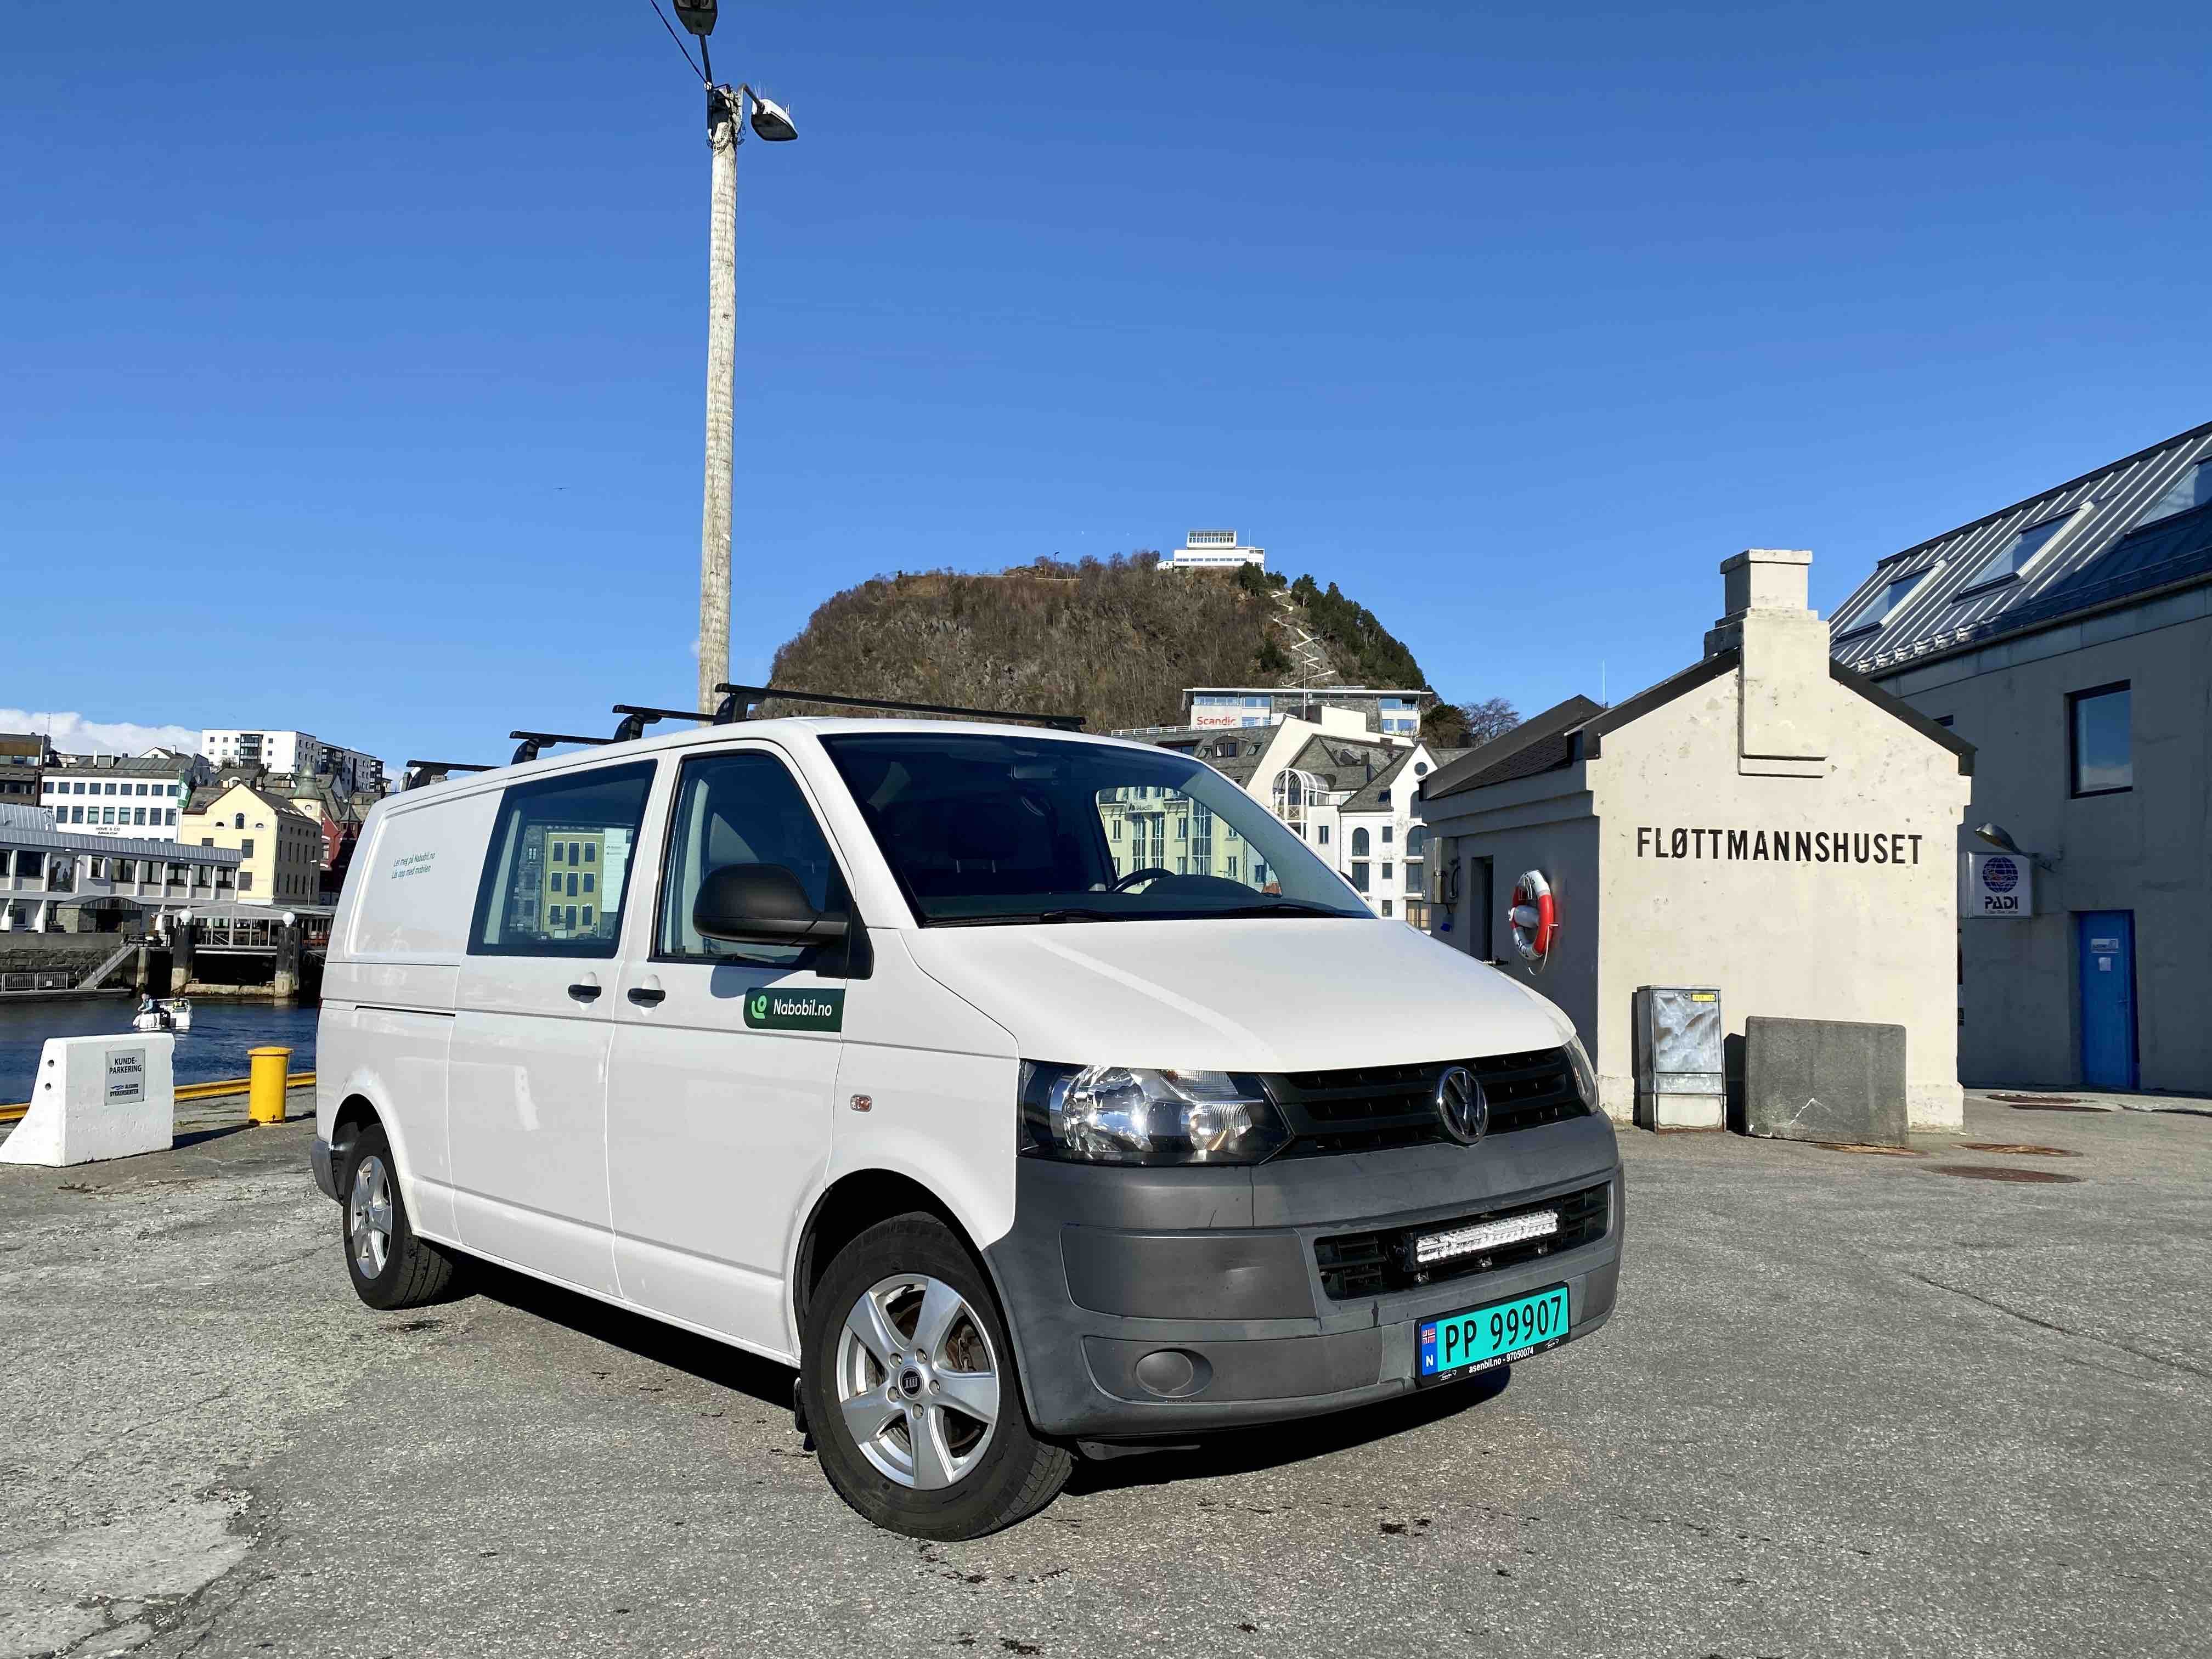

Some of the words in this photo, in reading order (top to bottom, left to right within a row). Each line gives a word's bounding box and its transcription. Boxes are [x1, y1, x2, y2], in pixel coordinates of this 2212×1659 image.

[1197, 716, 1237, 726] Scandic
[1637, 827, 1922, 865] FLØTTMANNSHUSET
[1984, 895, 2018, 909] PADI
[773, 998, 832, 1017] Nabobil.no
[114, 1057, 137, 1065] KUNDE-
[109, 1064, 142, 1075] PARKERING
[1445, 1319, 1477, 1363] PP
[1490, 1295, 1562, 1351] 99907
[1426, 1354, 1434, 1367] N
[1469, 1358, 1502, 1374] asenbil.no
[1506, 1346, 1534, 1362] 97050074
